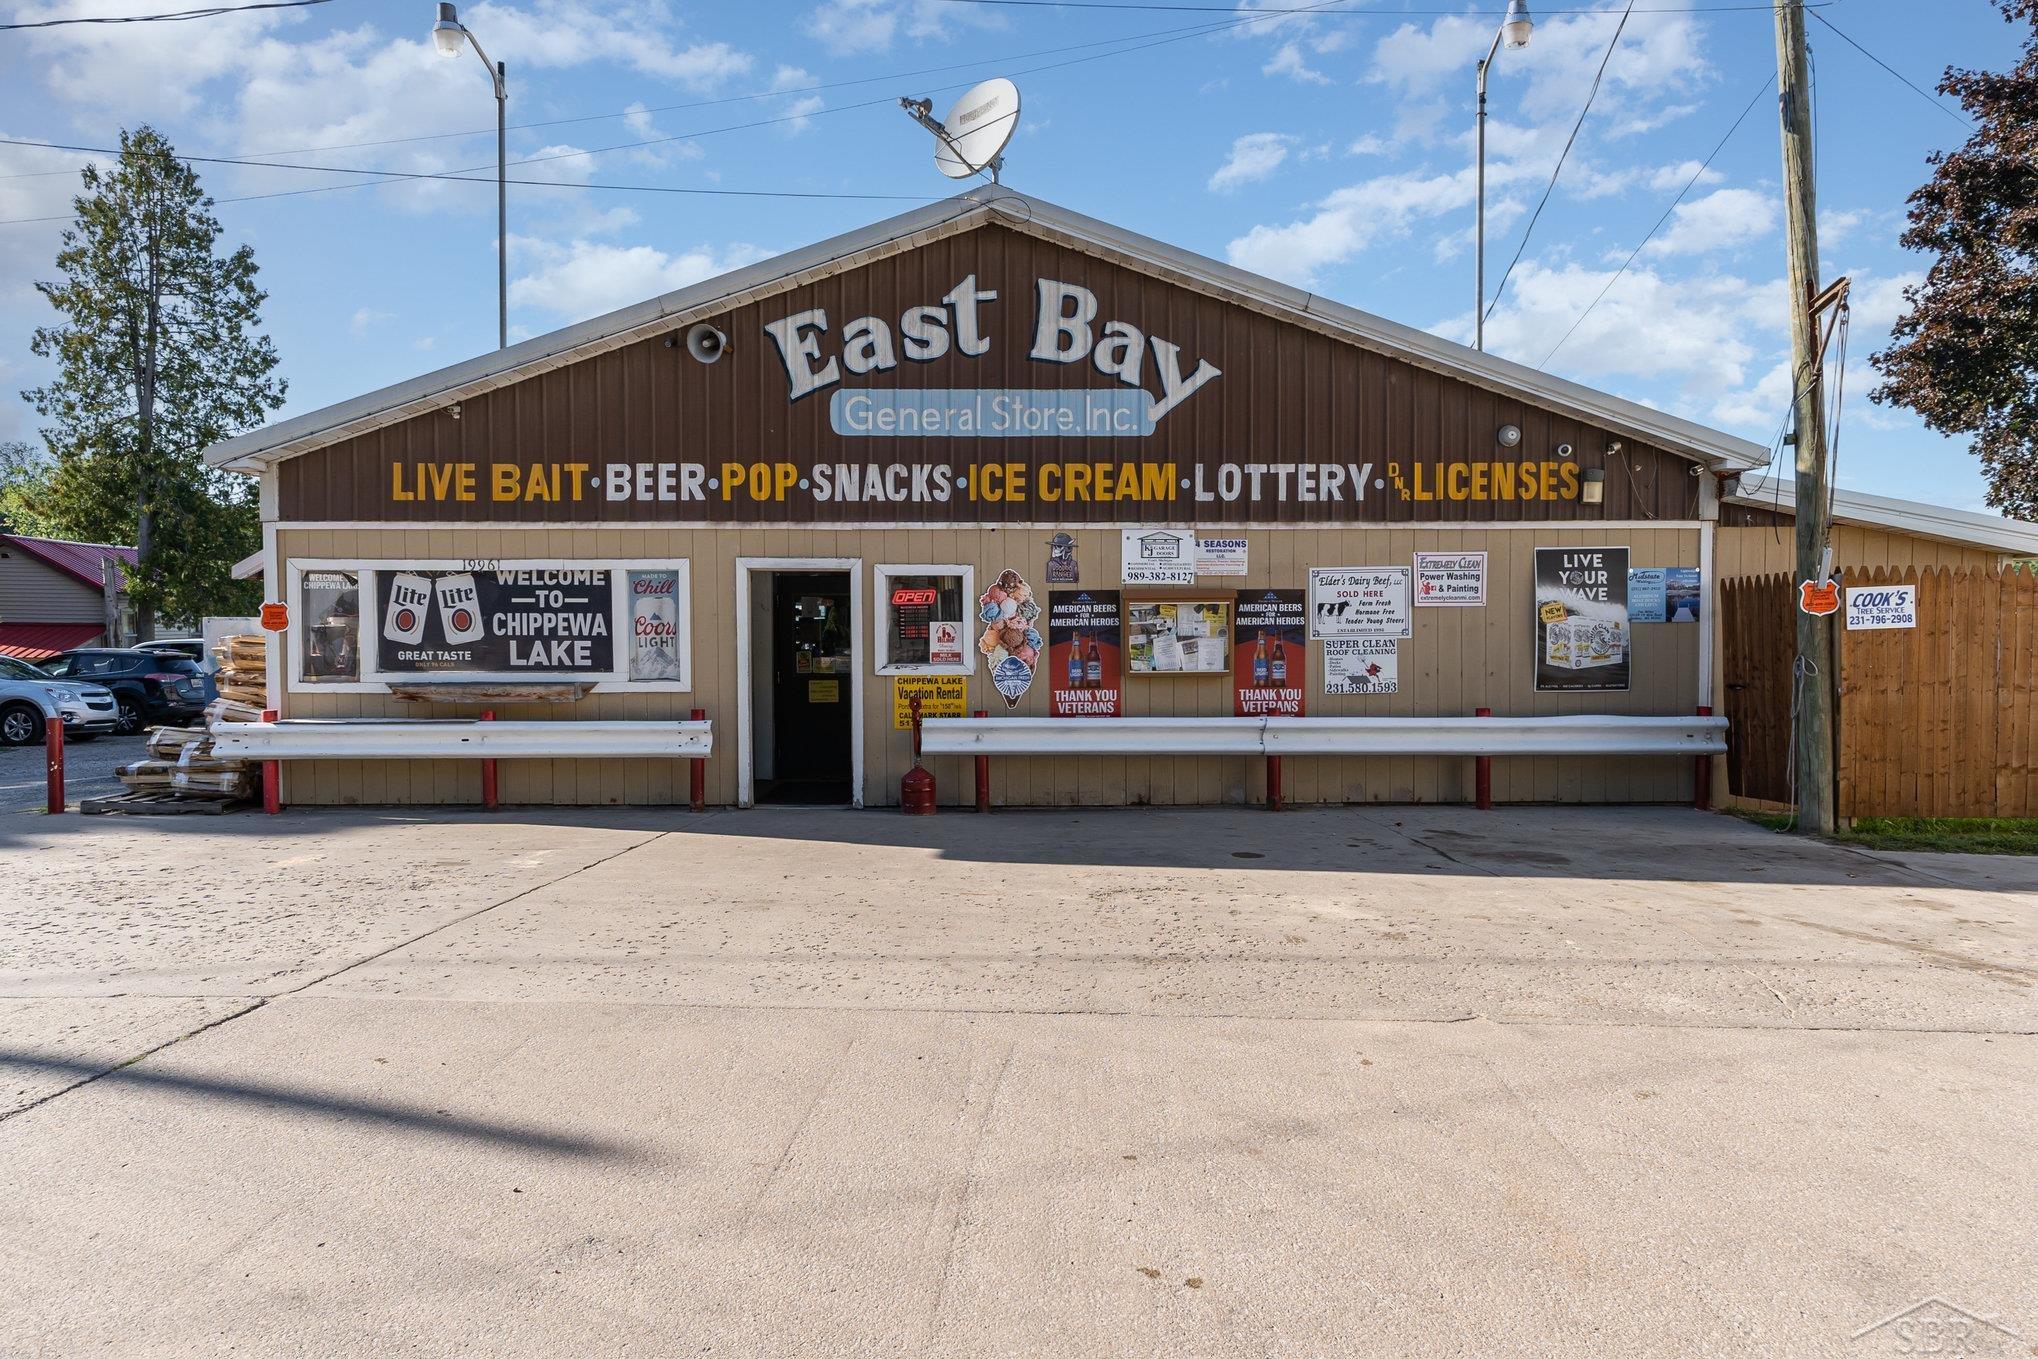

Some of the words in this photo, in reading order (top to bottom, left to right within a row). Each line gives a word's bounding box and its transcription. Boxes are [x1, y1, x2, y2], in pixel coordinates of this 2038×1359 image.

[763, 273, 998, 402] East
[1026, 277, 1223, 426] Bay
[844, 396, 982, 432] General
[392, 462, 476, 502] LIVE
[491, 463, 589, 502] BAIT
[606, 463, 706, 502] BEER
[721, 462, 798, 502] POP
[812, 463, 952, 502] SNACKS
[969, 463, 1026, 502] ICE
[1038, 463, 1177, 502] CREAM
[1194, 463, 1374, 502] LOTTERY
[1414, 462, 1581, 501] LICENSES
[1203, 540, 1247, 548] SEASONS
[1419, 556, 1458, 569] EXTREMELY
[1458, 556, 1482, 569] CLEAN
[1563, 553, 1603, 568] LIVE
[308, 573, 344, 582] WELCOME
[496, 570, 606, 586] WELCOME
[1127, 571, 1194, 581] 989-382-8127
[1318, 574, 1346, 586] Elder's
[1347, 576, 1372, 589] Dairy
[1372, 574, 1392, 589] Beef,
[1420, 572, 1445, 581] Power
[1446, 571, 1480, 582] Washing
[1558, 570, 1608, 585] YOUR
[303, 581, 341, 589] CHIPPEWA
[632, 579, 677, 595] Chill
[1438, 584, 1444, 592] &
[1446, 584, 1479, 594] Painting
[392, 584, 427, 607] Lite
[439, 587, 474, 609] Lite
[535, 590, 564, 608] TO
[895, 592, 933, 602] OPEN
[1363, 590, 1384, 598] HERE
[1559, 587, 1608, 601] WAVE
[1852, 590, 1909, 608] COOK'S
[1052, 604, 1092, 613] AMERICAN
[1092, 604, 1117, 613] BEERS
[1238, 603, 1278, 612] AMERICAN
[1278, 603, 1303, 612] BEERS
[1544, 606, 1562, 616] NEW
[1856, 607, 1874, 615] TREE
[1876, 606, 1906, 614] SERVICE
[492, 612, 608, 636] CHIPPEWA
[1050, 618, 1089, 627] AMERICAN
[1090, 617, 1120, 626] HEROES
[1235, 617, 1275, 626] AMERICAN
[1276, 616, 1305, 625] HEROES
[1345, 617, 1364, 625] Tender
[1366, 617, 1384, 626] Young
[1849, 614, 1913, 625] 231-796-2908
[634, 615, 677, 637] Coors
[638, 636, 675, 648] LIGHT
[1325, 640, 1360, 649] SUPER
[1362, 639, 1396, 648] CLEAN
[397, 651, 435, 660] GREAT
[436, 651, 472, 660] TASTE
[509, 640, 592, 666] LAKE
[1351, 648, 1396, 656] CLEANING
[897, 677, 940, 685] CHIPPEWA
[941, 677, 963, 685] LAKE
[897, 686, 934, 700] Vacation
[936, 686, 963, 700] Rental
[1326, 682, 1397, 694] 231.580.1593
[1053, 689, 1093, 702] THANK
[1094, 689, 1118, 702] YOU
[1238, 688, 1278, 701] THANK
[1279, 688, 1302, 700] YOU
[1057, 701, 1115, 714] VETERANS
